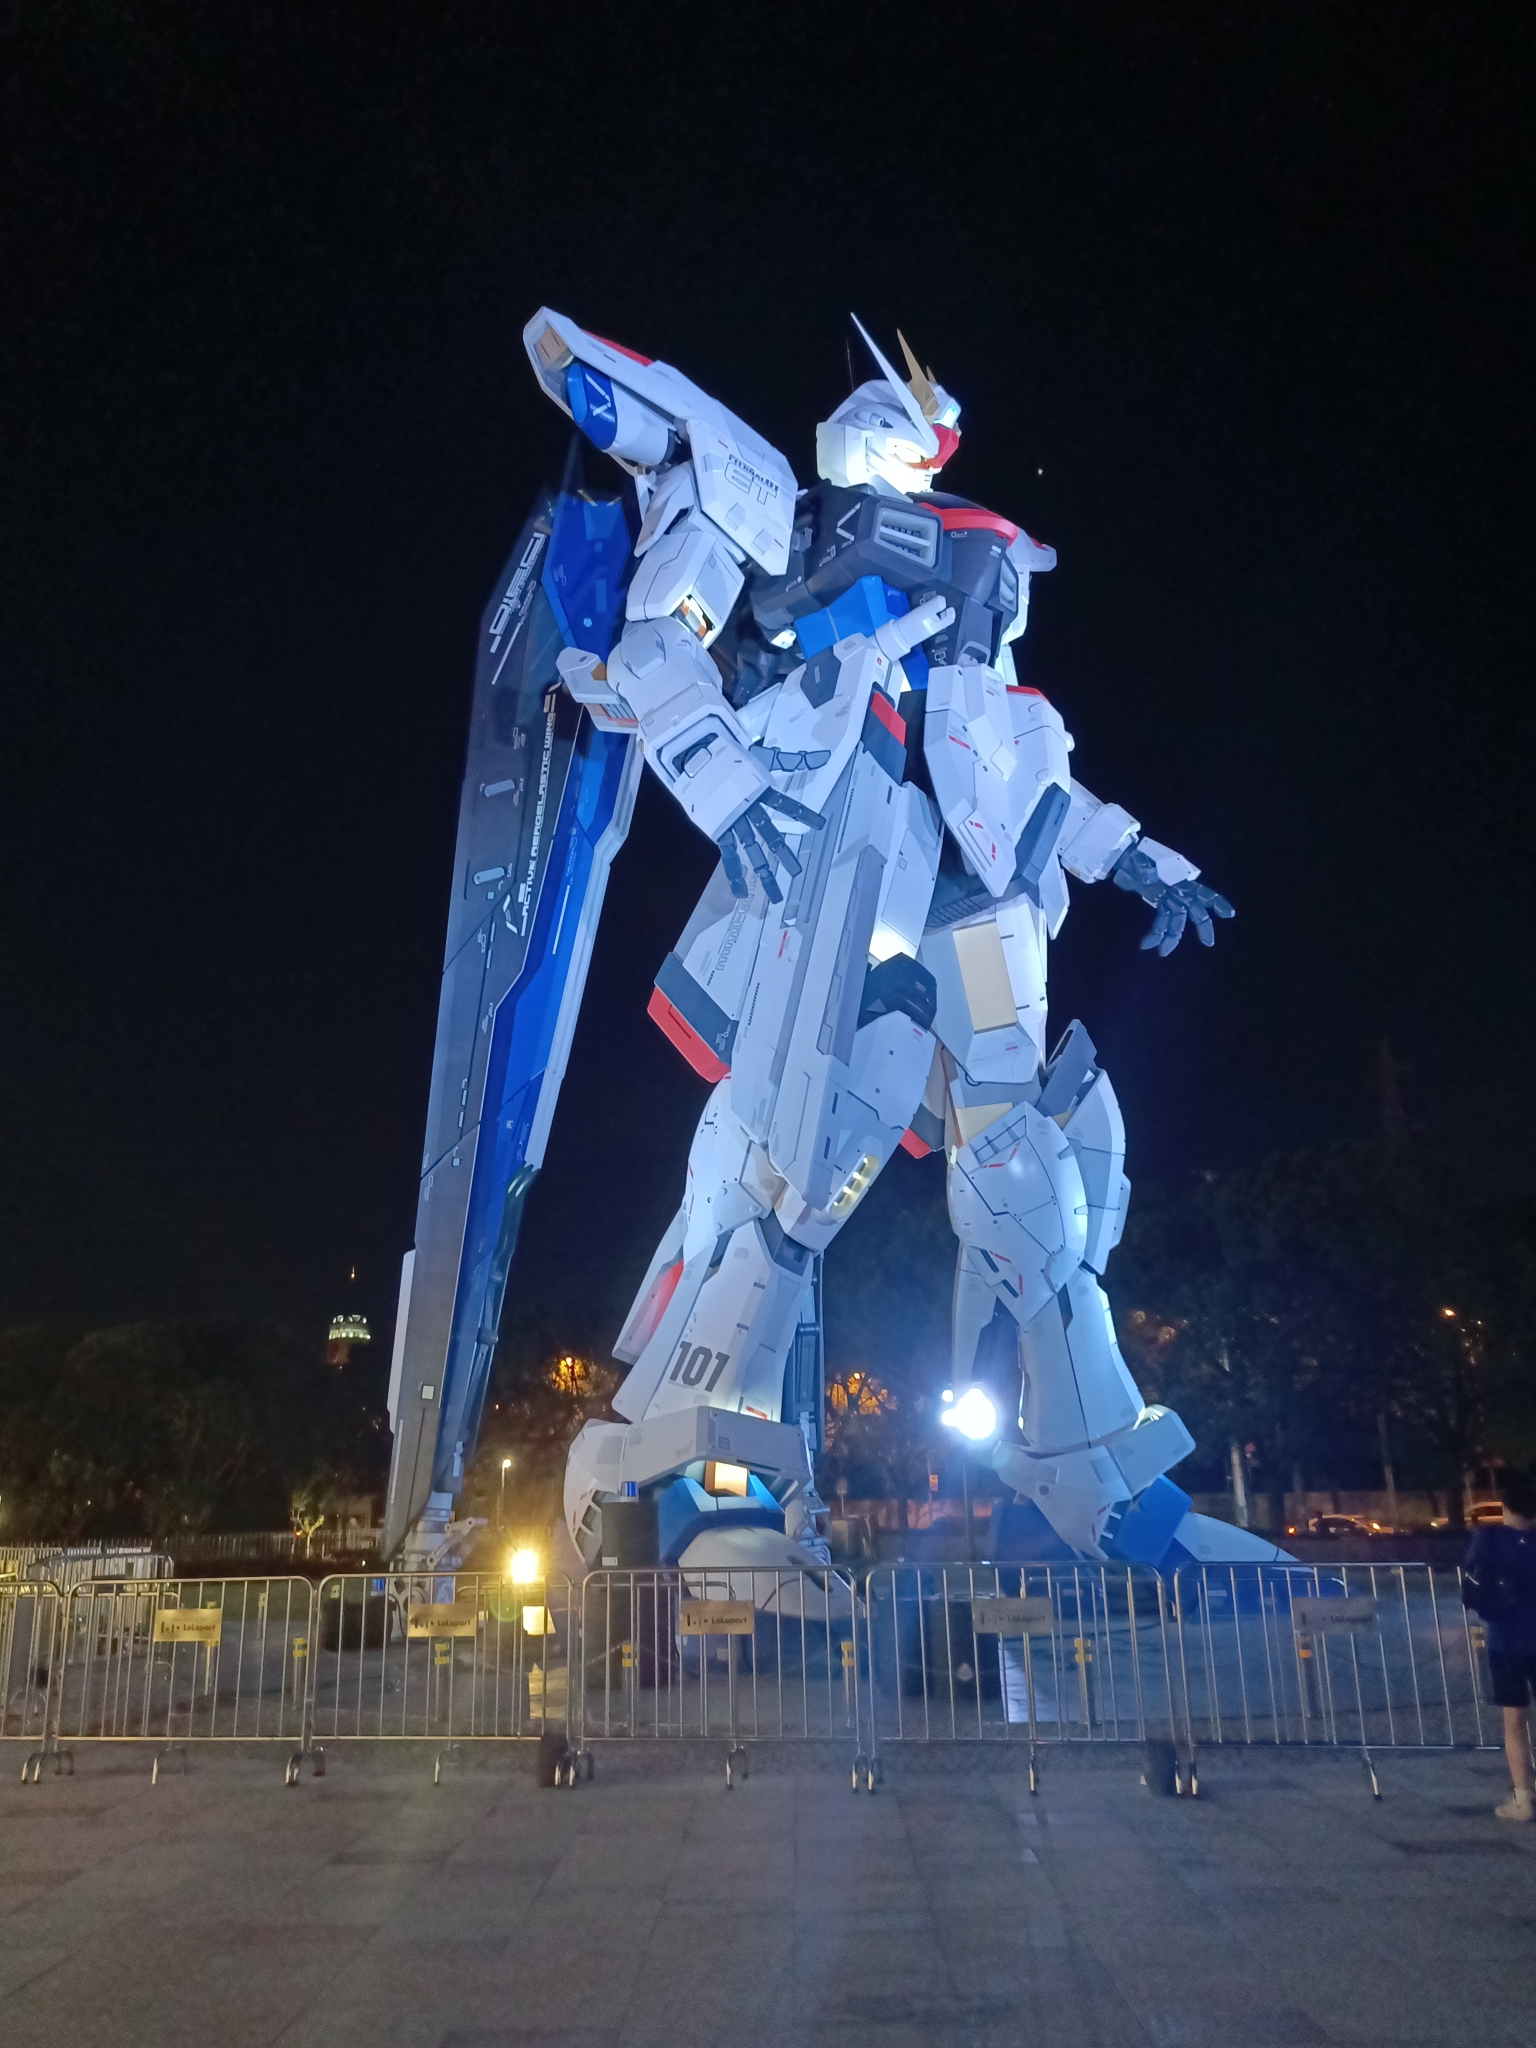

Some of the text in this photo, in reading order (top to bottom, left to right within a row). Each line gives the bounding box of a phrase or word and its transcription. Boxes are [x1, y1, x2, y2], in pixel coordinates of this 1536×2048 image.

[521, 860, 536, 916] ACTIVE
[543, 712, 554, 749] WING
[669, 1340, 731, 1393] 101
